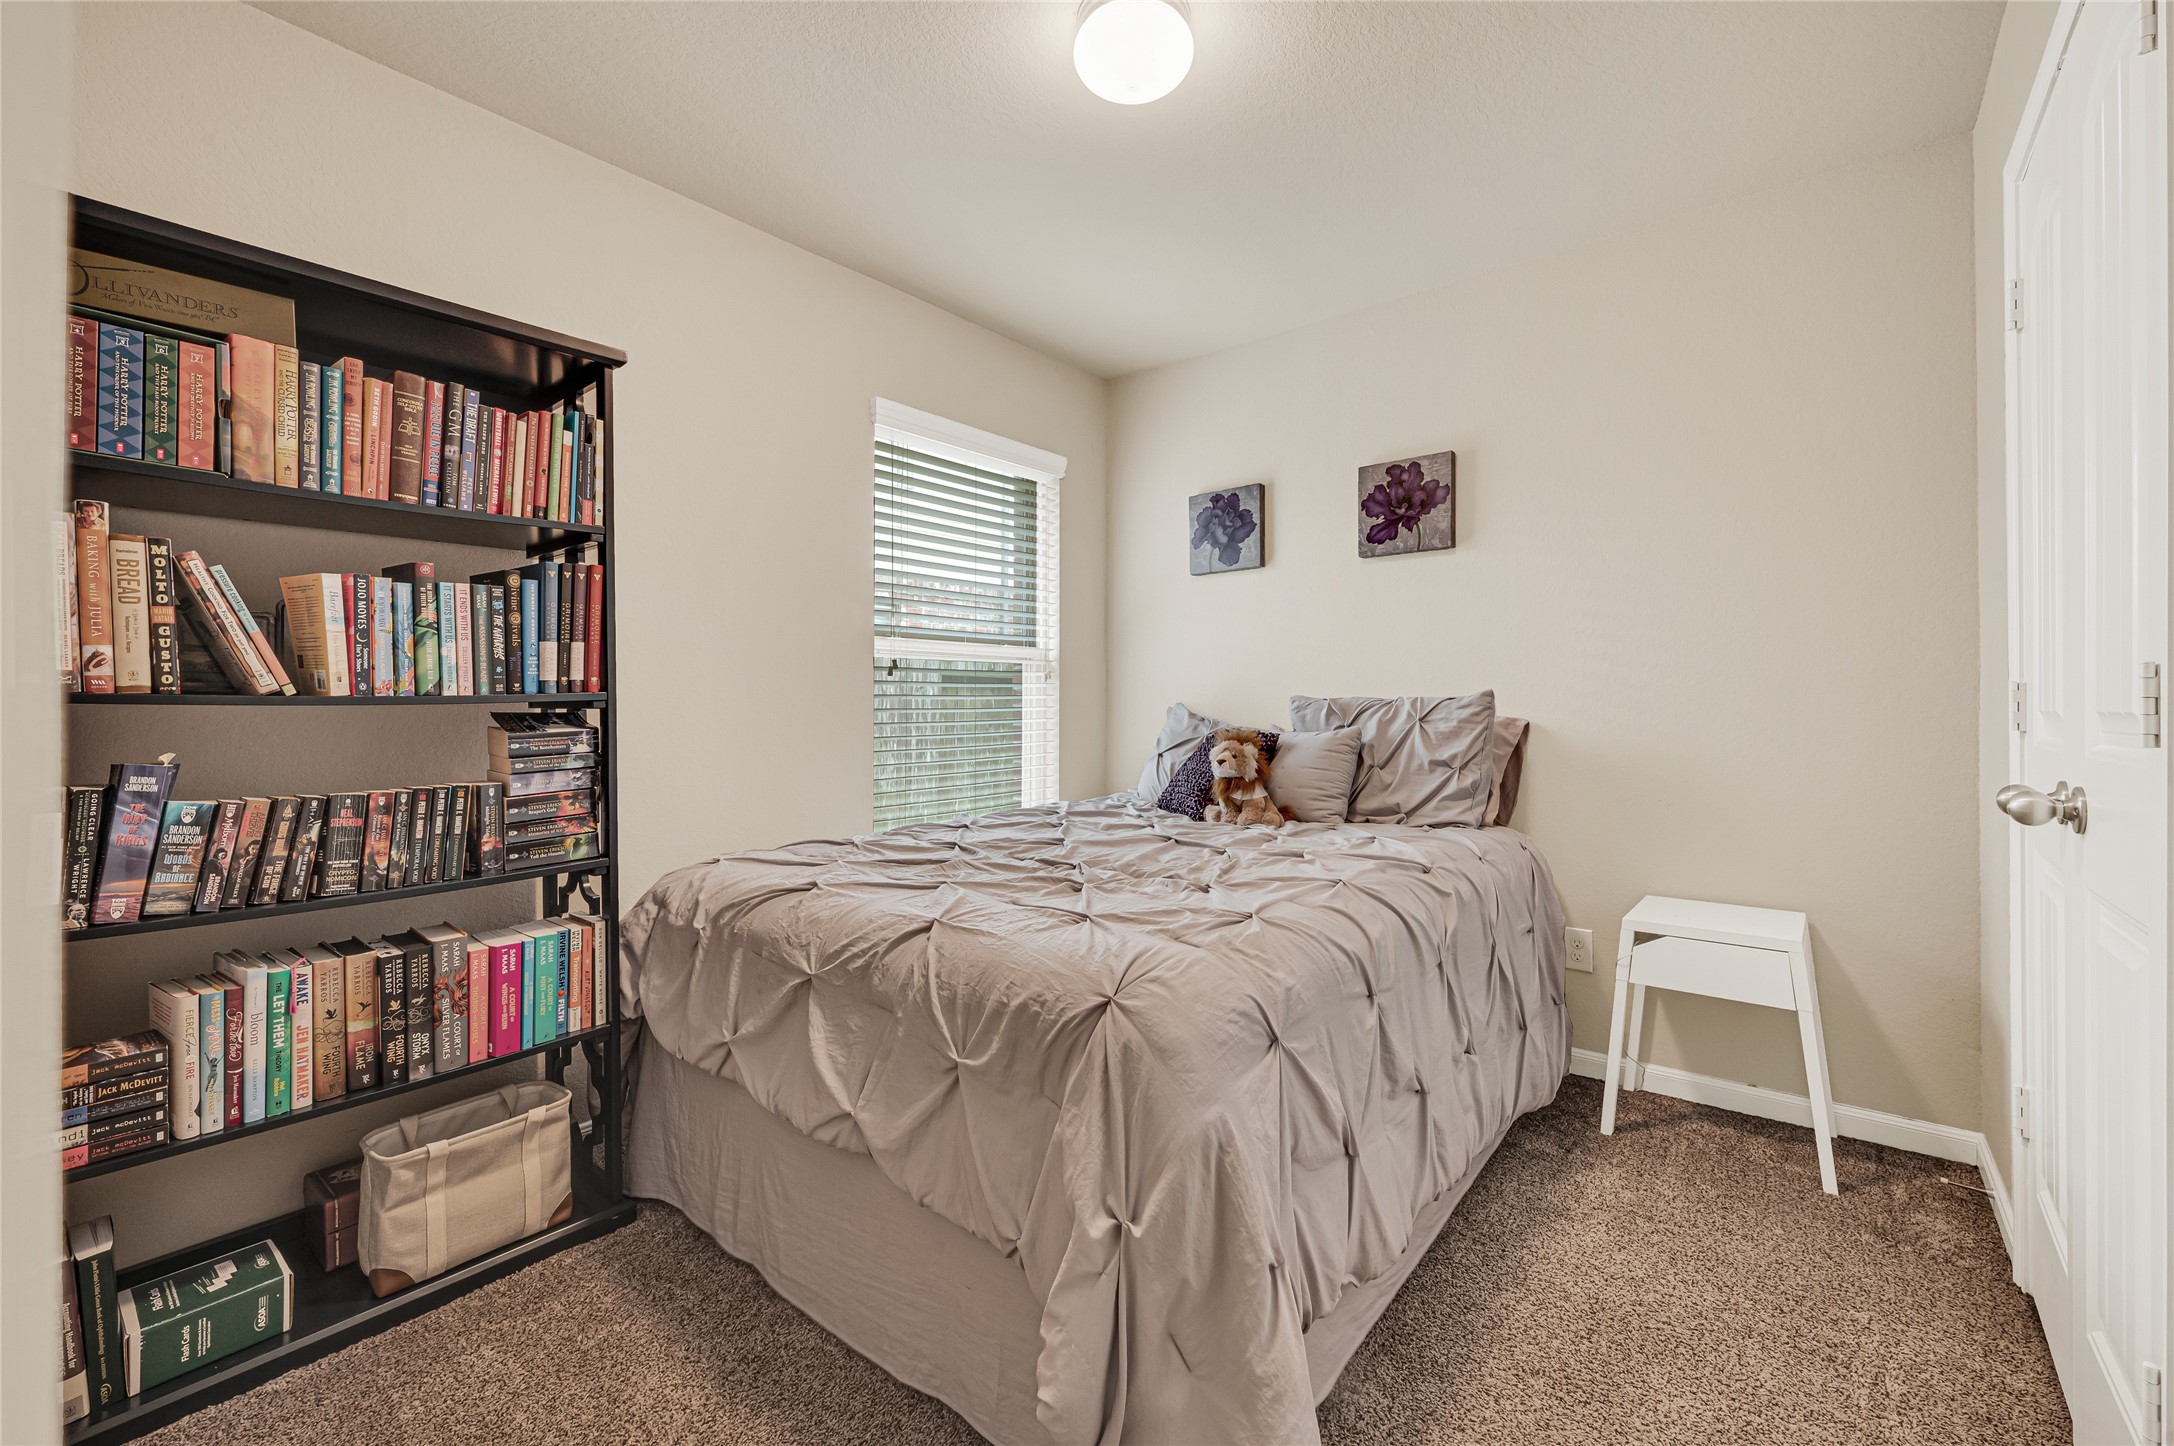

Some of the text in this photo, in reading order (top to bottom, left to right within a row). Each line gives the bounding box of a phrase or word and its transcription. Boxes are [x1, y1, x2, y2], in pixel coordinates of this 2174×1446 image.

[73, 345, 84, 418] HARRY POTTER
[119, 357, 129, 427] HARRY POTTER
[285, 370, 297, 404] HARRY
[160, 365, 169, 434] HARRY POTTER
[195, 374, 203, 441] HARRY POTTER
[277, 388, 285, 437] CURSED CHILD
[452, 391, 461, 407] THE
[285, 404, 297, 441] POTTER
[431, 422, 443, 437] DIE
[465, 402, 478, 444] THE DRAFT
[369, 434, 377, 465] LINCHPIN
[431, 438, 443, 448] IN
[429, 449, 443, 477] PEACE
[491, 412, 503, 504] MONEYBALL MICHAEL LEWIS
[445, 462, 453, 494] CALLAHAN
[86, 535, 103, 637] BAKING with JULIA
[116, 558, 142, 605] BREAD
[150, 544, 174, 685] MOLTO GUSTO
[357, 577, 367, 630] JOJO MOYES
[444, 593, 452, 616] STARTS
[460, 597, 468, 614] ENDS
[444, 617, 453, 634] WITH
[461, 615, 469, 632] WITH
[461, 633, 469, 641] US
[493, 614, 505, 660] THE NATURALS
[445, 635, 454, 644] US
[479, 625, 487, 661] ASSASSIN'S
[124, 783, 159, 793] SANDERSON
[129, 776, 157, 784] BRANDON
[87, 793, 98, 841] GOING CLEAR
[129, 803, 145, 813] THE
[340, 808, 353, 818] NEAL
[418, 801, 426, 814] PETER
[456, 798, 464, 810] PETER
[127, 825, 139, 834] OF
[168, 825, 201, 835] BRANDON
[220, 818, 236, 848] Mistborn
[253, 811, 266, 838] AMONG
[115, 835, 149, 847] KINGS
[162, 834, 203, 845] SANDERSON
[163, 853, 193, 865] WORDS
[172, 865, 181, 873] OF
[413, 843, 422, 869] TEMPORAL
[71, 864, 80, 893] WRIGHT
[79, 858, 90, 899] LAWRENCE
[154, 872, 195, 884] RADIANCE
[262, 866, 274, 889] OF GOD
[268, 860, 284, 895] THE FORGE
[328, 869, 357, 877] CRYPTO-
[431, 866, 439, 880] VOID
[203, 873, 216, 905] SANDERSON
[210, 876, 221, 902] BRANDON
[411, 958, 419, 988] YARROS
[441, 950, 449, 973] MAAS
[509, 948, 517, 972] SARAH
[320, 971, 328, 1003] YARROS
[331, 967, 339, 1003] REBECCA
[365, 960, 373, 997] REBECCA
[395, 959, 403, 994] REBECCA
[558, 961, 566, 988] WELSH
[571, 955, 580, 1003] Trainspotting
[211, 999, 221, 1023] MESS
[272, 994, 285, 1015] LET
[557, 998, 565, 1022] FILTH
[250, 1012, 264, 1046] bloom
[272, 1015, 285, 1049] THEM
[296, 972, 310, 1101] AWAKE JEN HATMAKER
[441, 998, 451, 1060] SILVER FLAMES
[453, 1021, 462, 1049] COURT
[185, 1009, 195, 1080] FIERCE FIRE
[355, 1040, 366, 1071] FLAME
[365, 1042, 374, 1063] IRON
[386, 1041, 396, 1063] WING
[395, 1034, 405, 1066] FOURTH
[412, 1032, 421, 1061] STORM
[421, 1032, 430, 1056] ONYX
[322, 1052, 332, 1075] WING
[331, 1045, 341, 1078] FOURTH
[98, 1085, 118, 1098] JACK
[151, 1298, 164, 1312] Flash
[257, 1307, 267, 1327] ASOA
[62, 1302, 76, 1359] Accounting Handbook
[180, 1325, 190, 1362] Flash Cards
